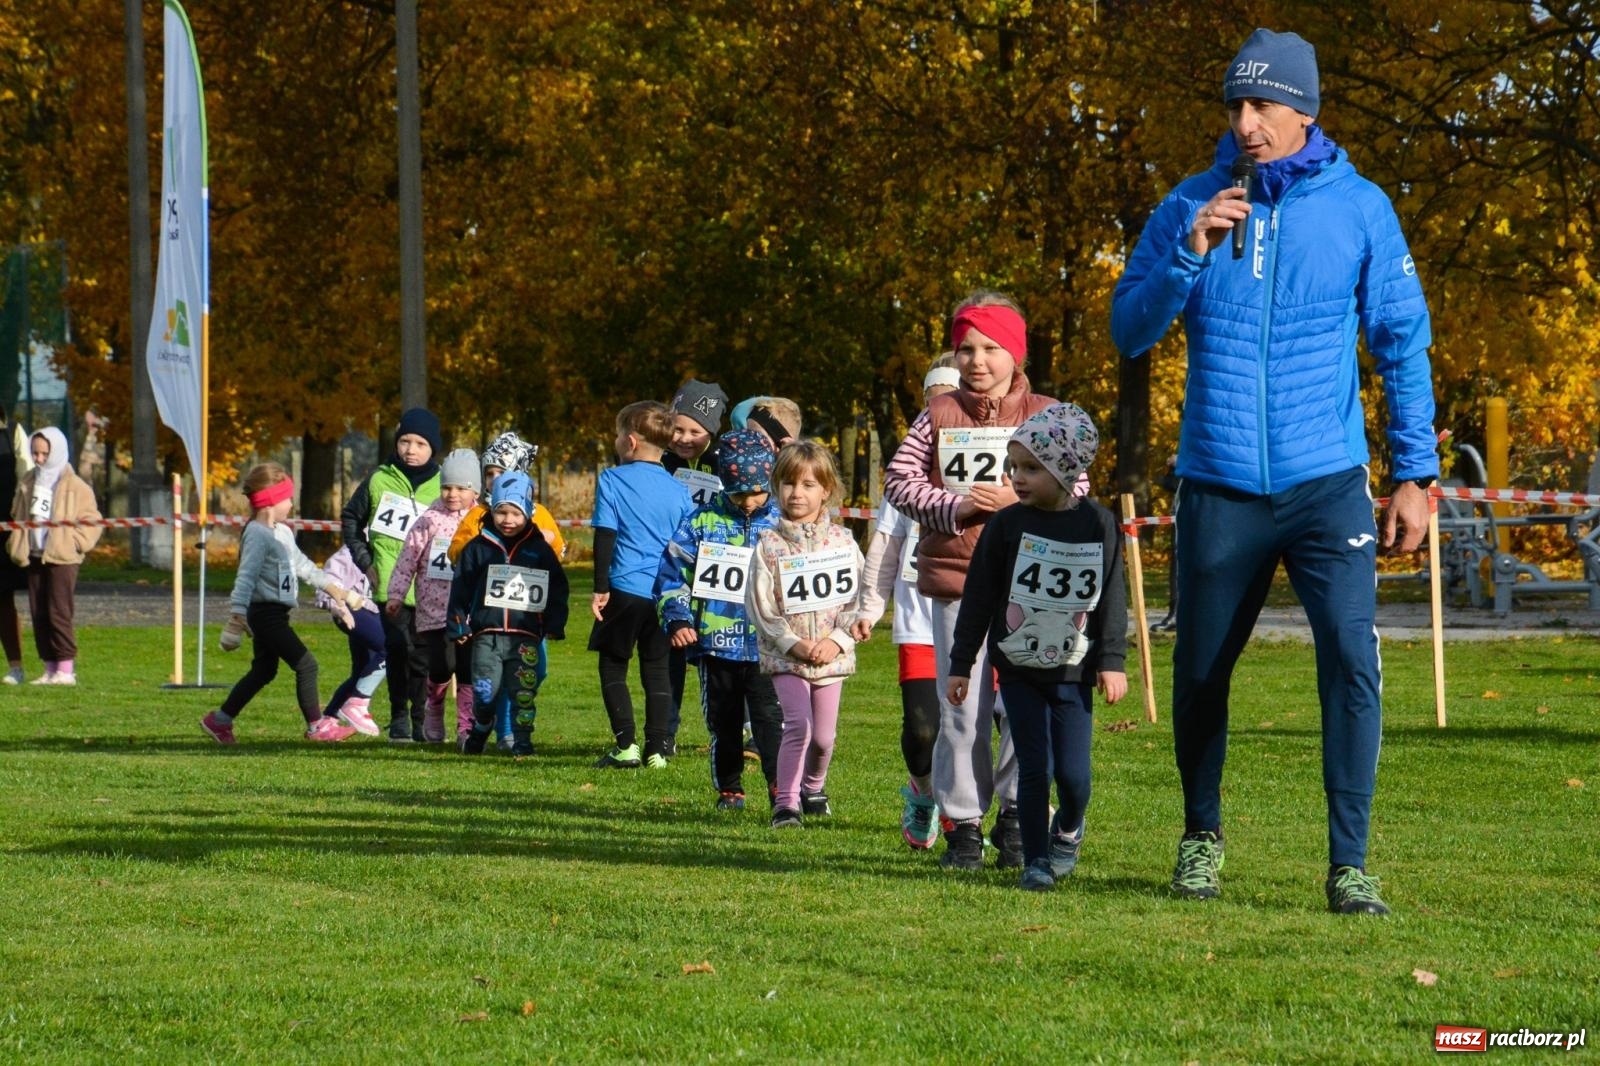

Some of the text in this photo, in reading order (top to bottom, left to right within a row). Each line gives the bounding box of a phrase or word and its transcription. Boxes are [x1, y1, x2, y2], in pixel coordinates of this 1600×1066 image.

[1257, 79, 1303, 96] seventeen
[378, 509, 410, 532] 41
[699, 563, 744, 592] 40
[787, 568, 853, 601] 405
[1016, 562, 1097, 600] 433
[489, 579, 544, 604] 520
